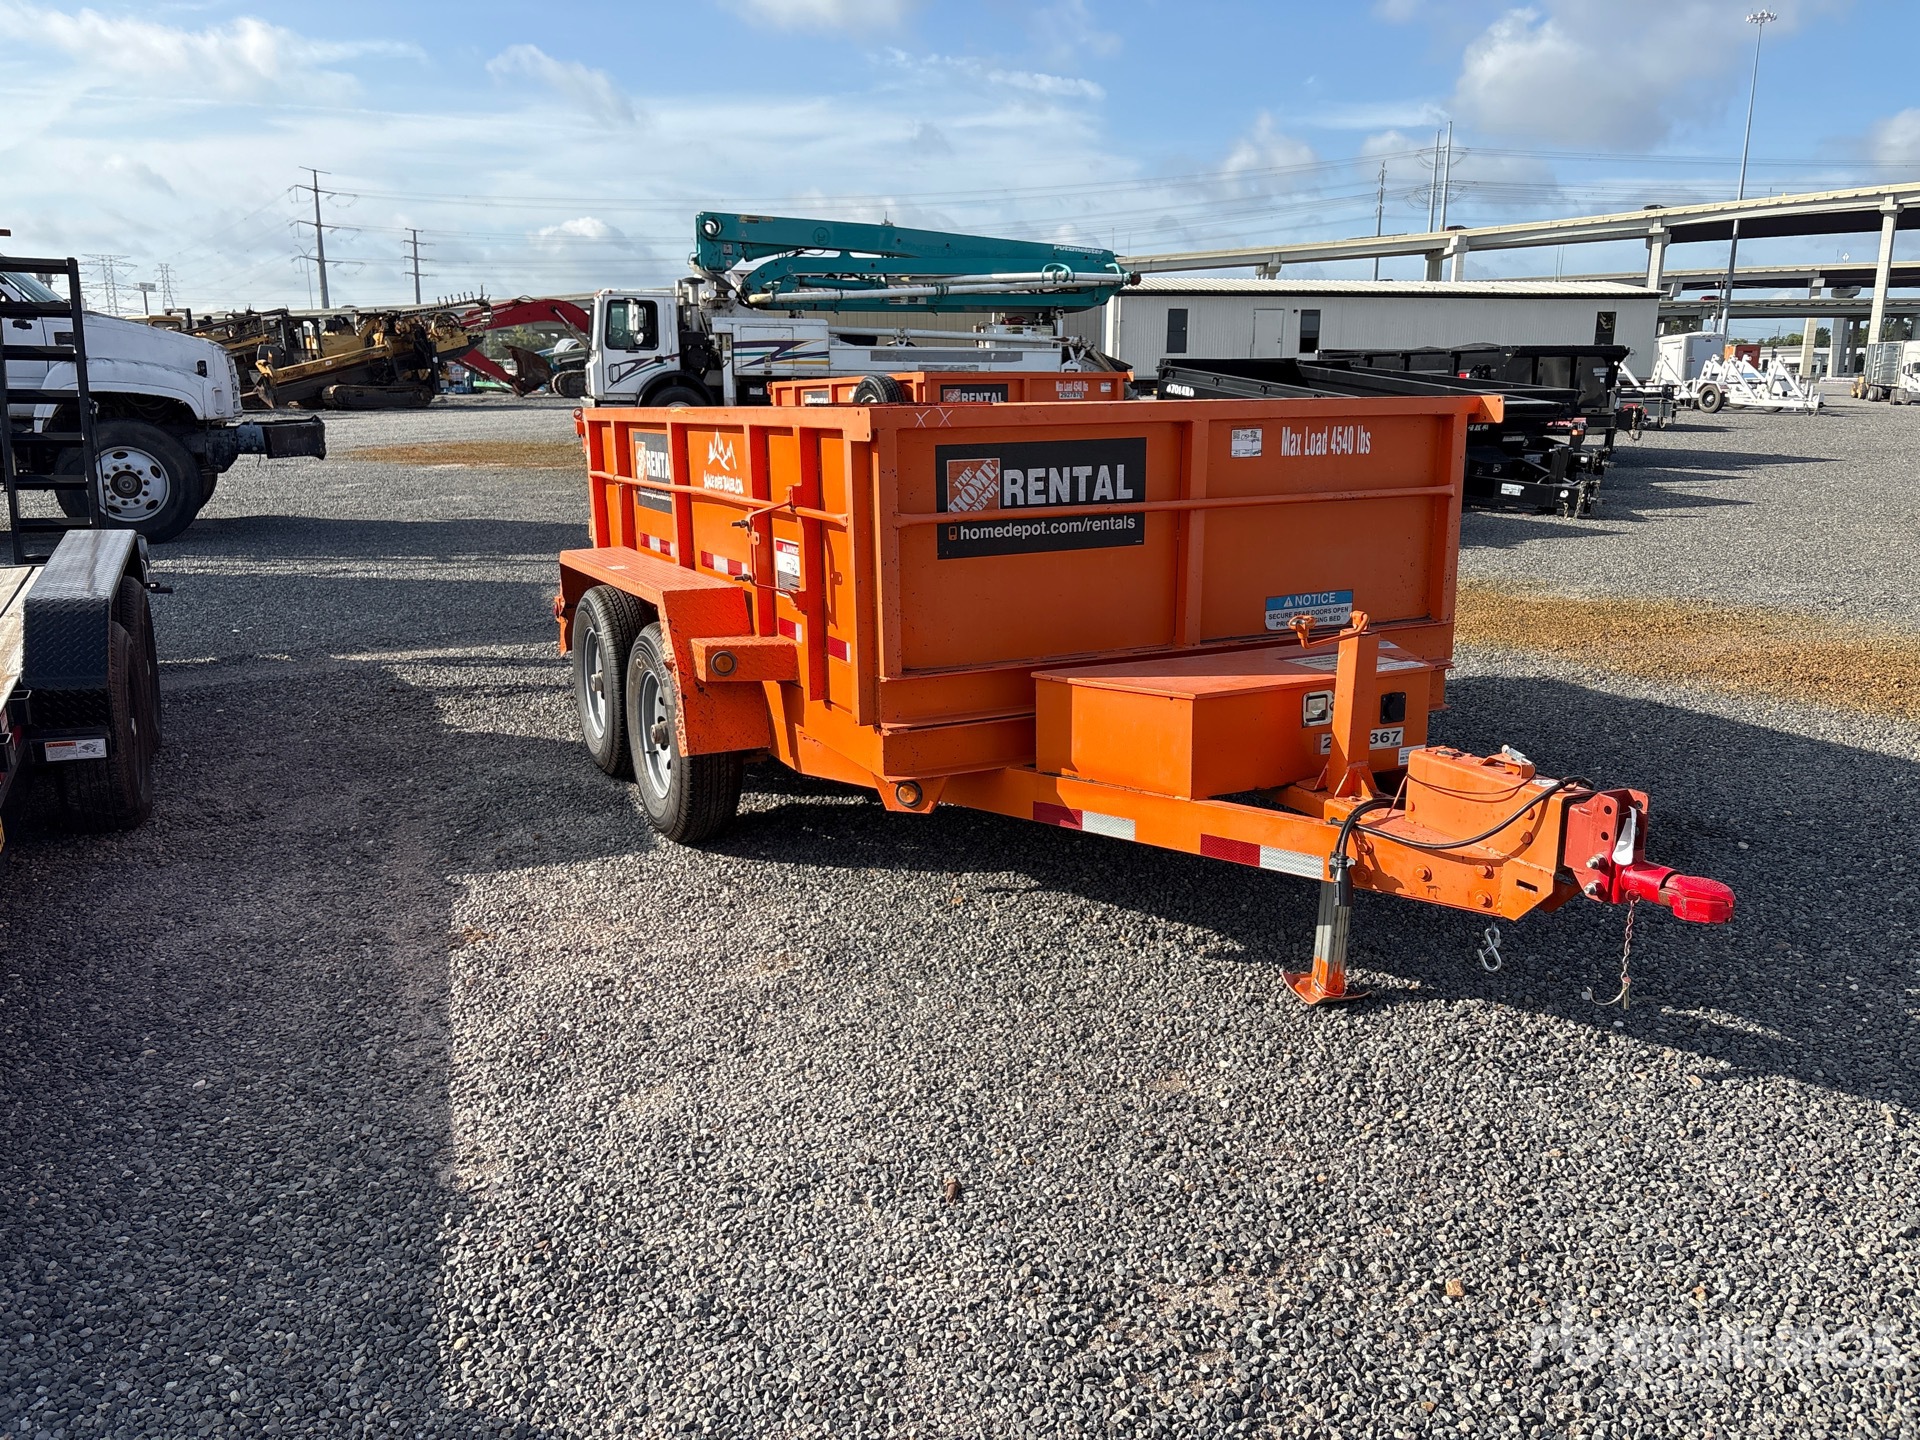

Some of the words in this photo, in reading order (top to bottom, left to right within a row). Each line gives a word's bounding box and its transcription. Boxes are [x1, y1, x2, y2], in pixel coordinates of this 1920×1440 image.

[961, 391, 1005, 403] RENTAL
[1281, 426, 1302, 457] Max
[1304, 425, 1328, 456] Load
[1330, 425, 1354, 455] 4540
[1356, 424, 1371, 454] lbs
[646, 449, 671, 479] RENTA
[953, 466, 975, 490] THE
[949, 459, 999, 513] HOME
[969, 480, 999, 511] DEPOT
[1003, 463, 1134, 507] RENTAL
[960, 515, 1136, 541] homedepot.com/rentals
[1268, 611, 1293, 620] SECURE
[1294, 609, 1310, 617] REAR
[1311, 608, 1332, 616] DOORS
[1333, 606, 1349, 614] OPEN
[1295, 592, 1336, 607] NOTICE
